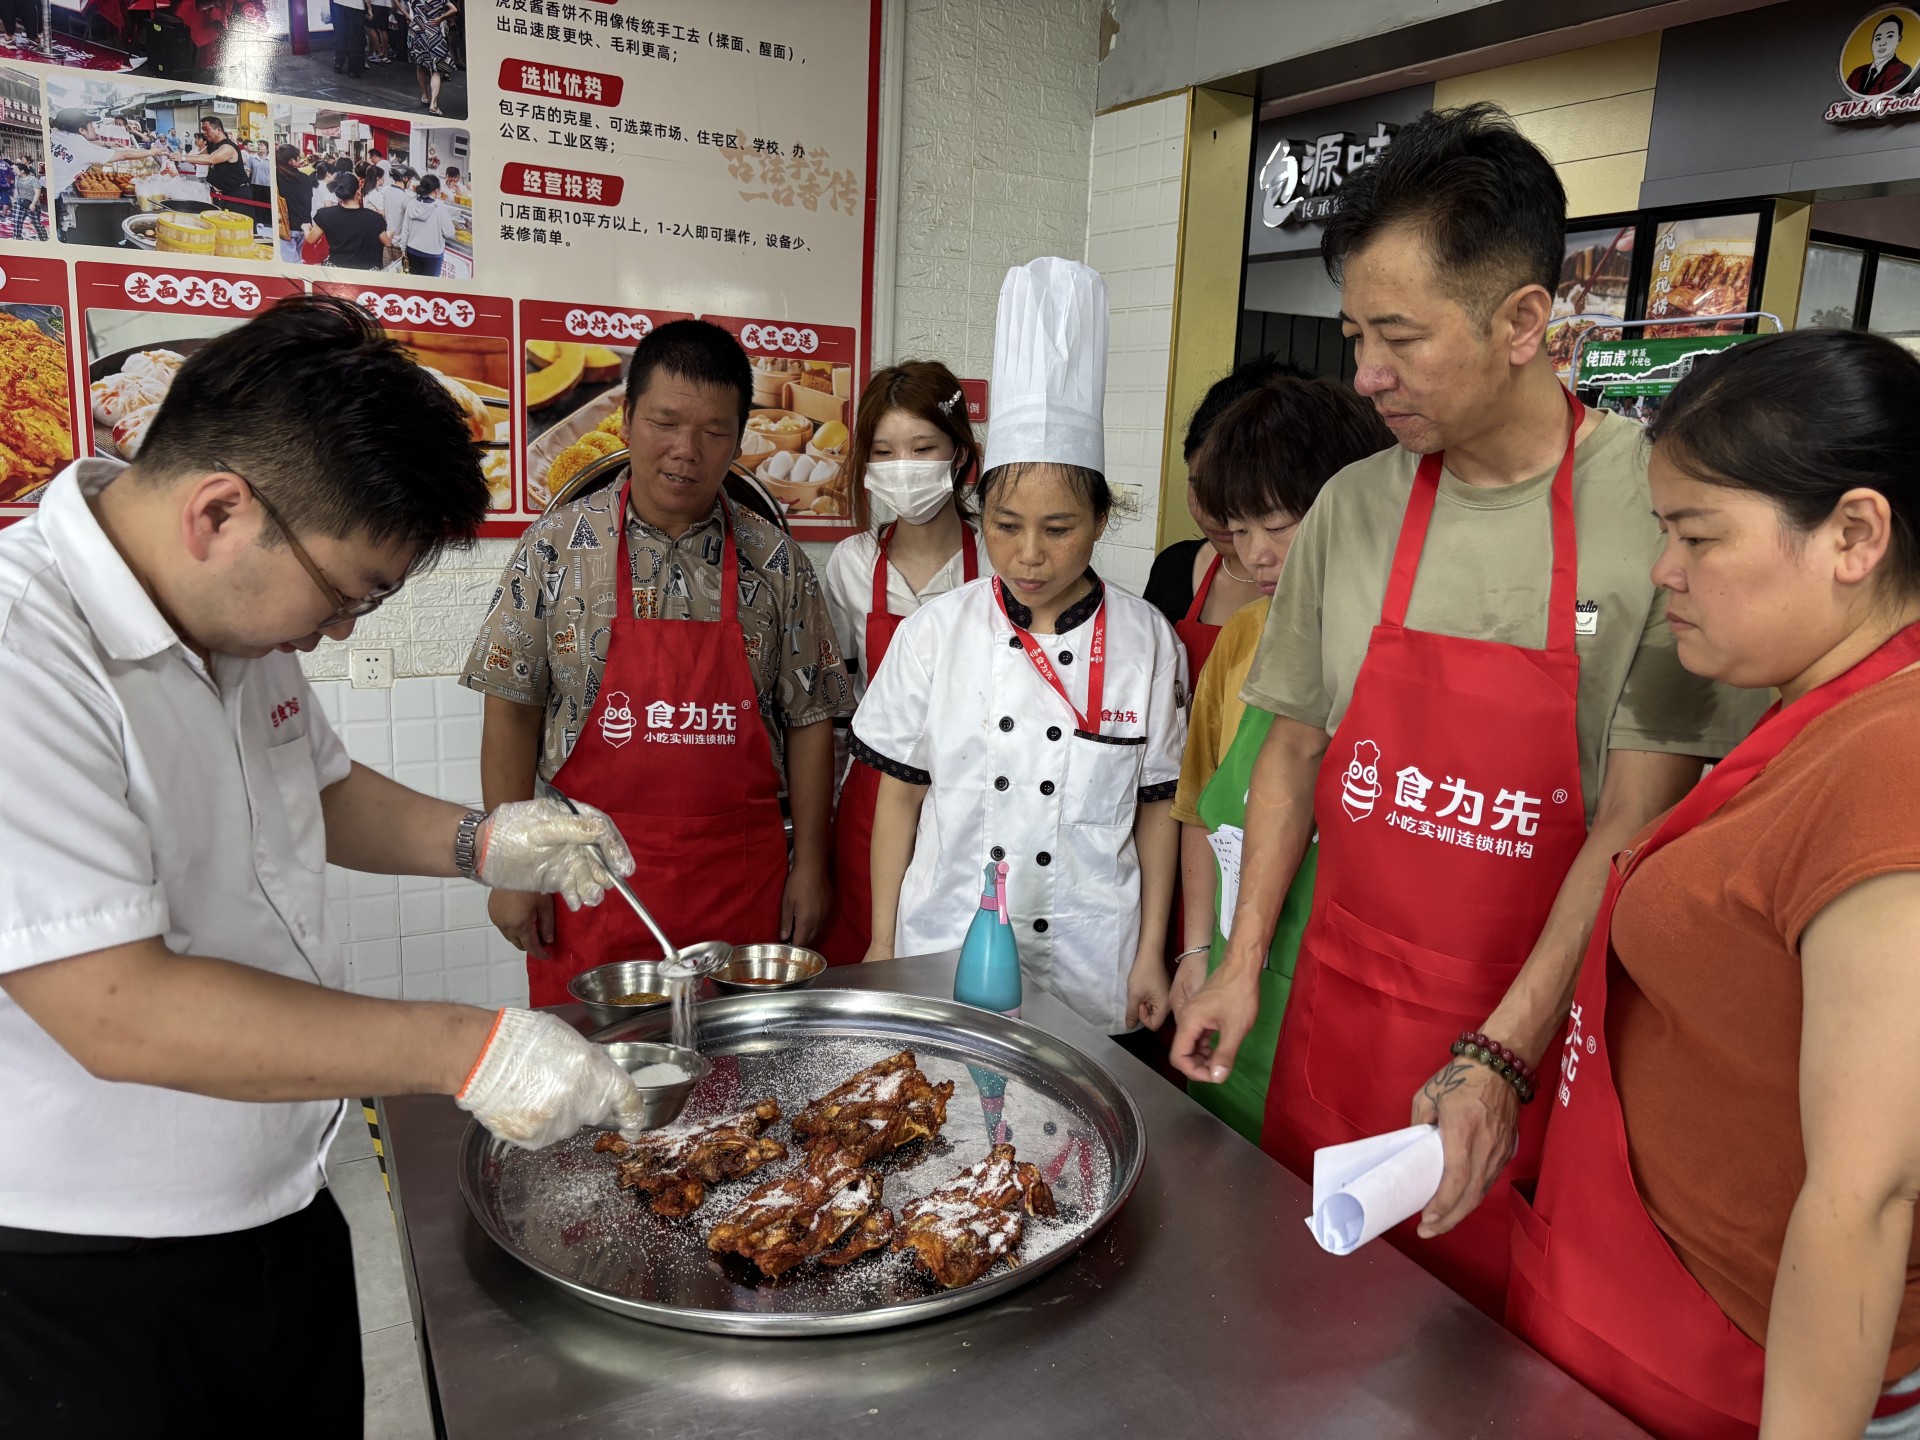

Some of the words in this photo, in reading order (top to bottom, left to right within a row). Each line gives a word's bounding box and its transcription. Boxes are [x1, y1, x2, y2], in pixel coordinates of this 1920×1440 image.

[496, 16, 678, 63] 出品速度更快、毛利更高；
[521, 65, 603, 101] 选址优势
[499, 99, 806, 159] 包子店的克星、可选菜市场、住宅区、学校、办
[500, 122, 616, 154] 公区、工业区等；
[522, 169, 603, 201] 经营投资
[499, 201, 812, 252] 门店面积10平方以上，1-2人即可操作，设备少、
[500, 224, 571, 247] 装修简单。
[127, 276, 260, 308] 老面大包子
[570, 313, 652, 338] 油炸小吃
[746, 323, 816, 351] 成品配送
[1575, 599, 1598, 613] hello
[1093, 627, 1103, 654] 食为先
[1035, 656, 1055, 681] 食为先
[645, 700, 737, 731] 食为先
[1100, 708, 1138, 724] 食为先
[643, 731, 736, 746] 小吃实训连锁机构
[1394, 765, 1542, 837] 食为先
[1385, 810, 1534, 859] 小吃实训连锁机构
